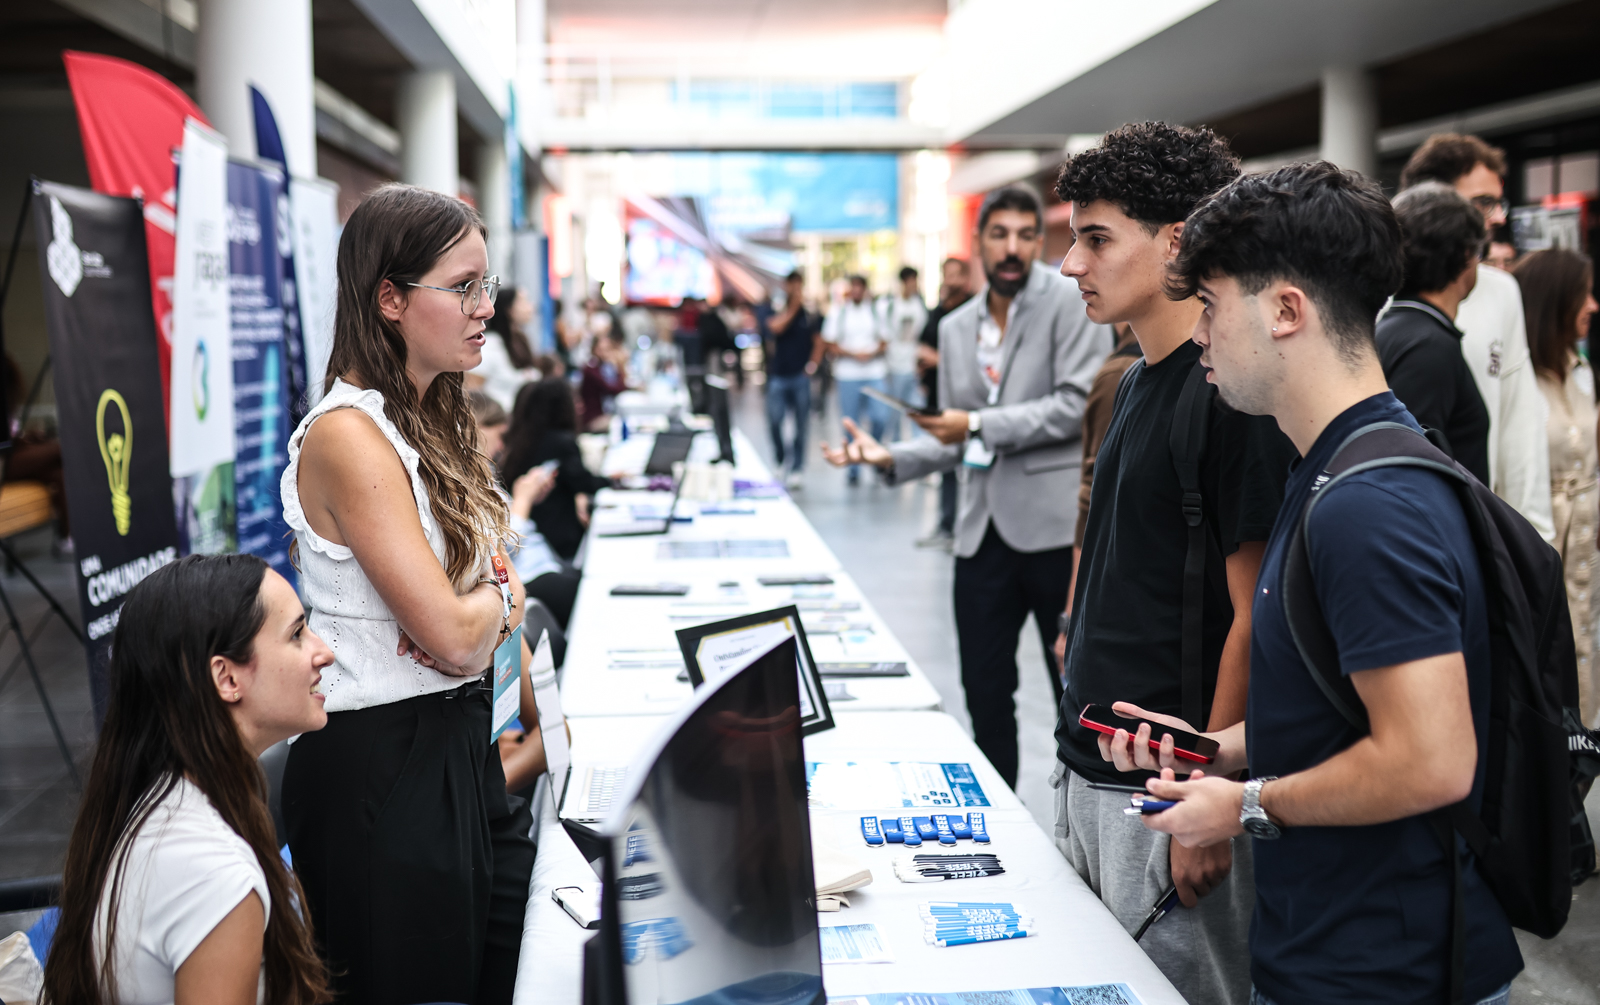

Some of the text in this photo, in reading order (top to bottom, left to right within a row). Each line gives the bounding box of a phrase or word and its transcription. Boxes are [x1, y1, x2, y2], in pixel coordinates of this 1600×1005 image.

[863, 818, 879, 836] IEEE
[901, 816, 914, 832] IEEE
[938, 815, 949, 830] IEEE
[970, 812, 984, 831] IEEE
